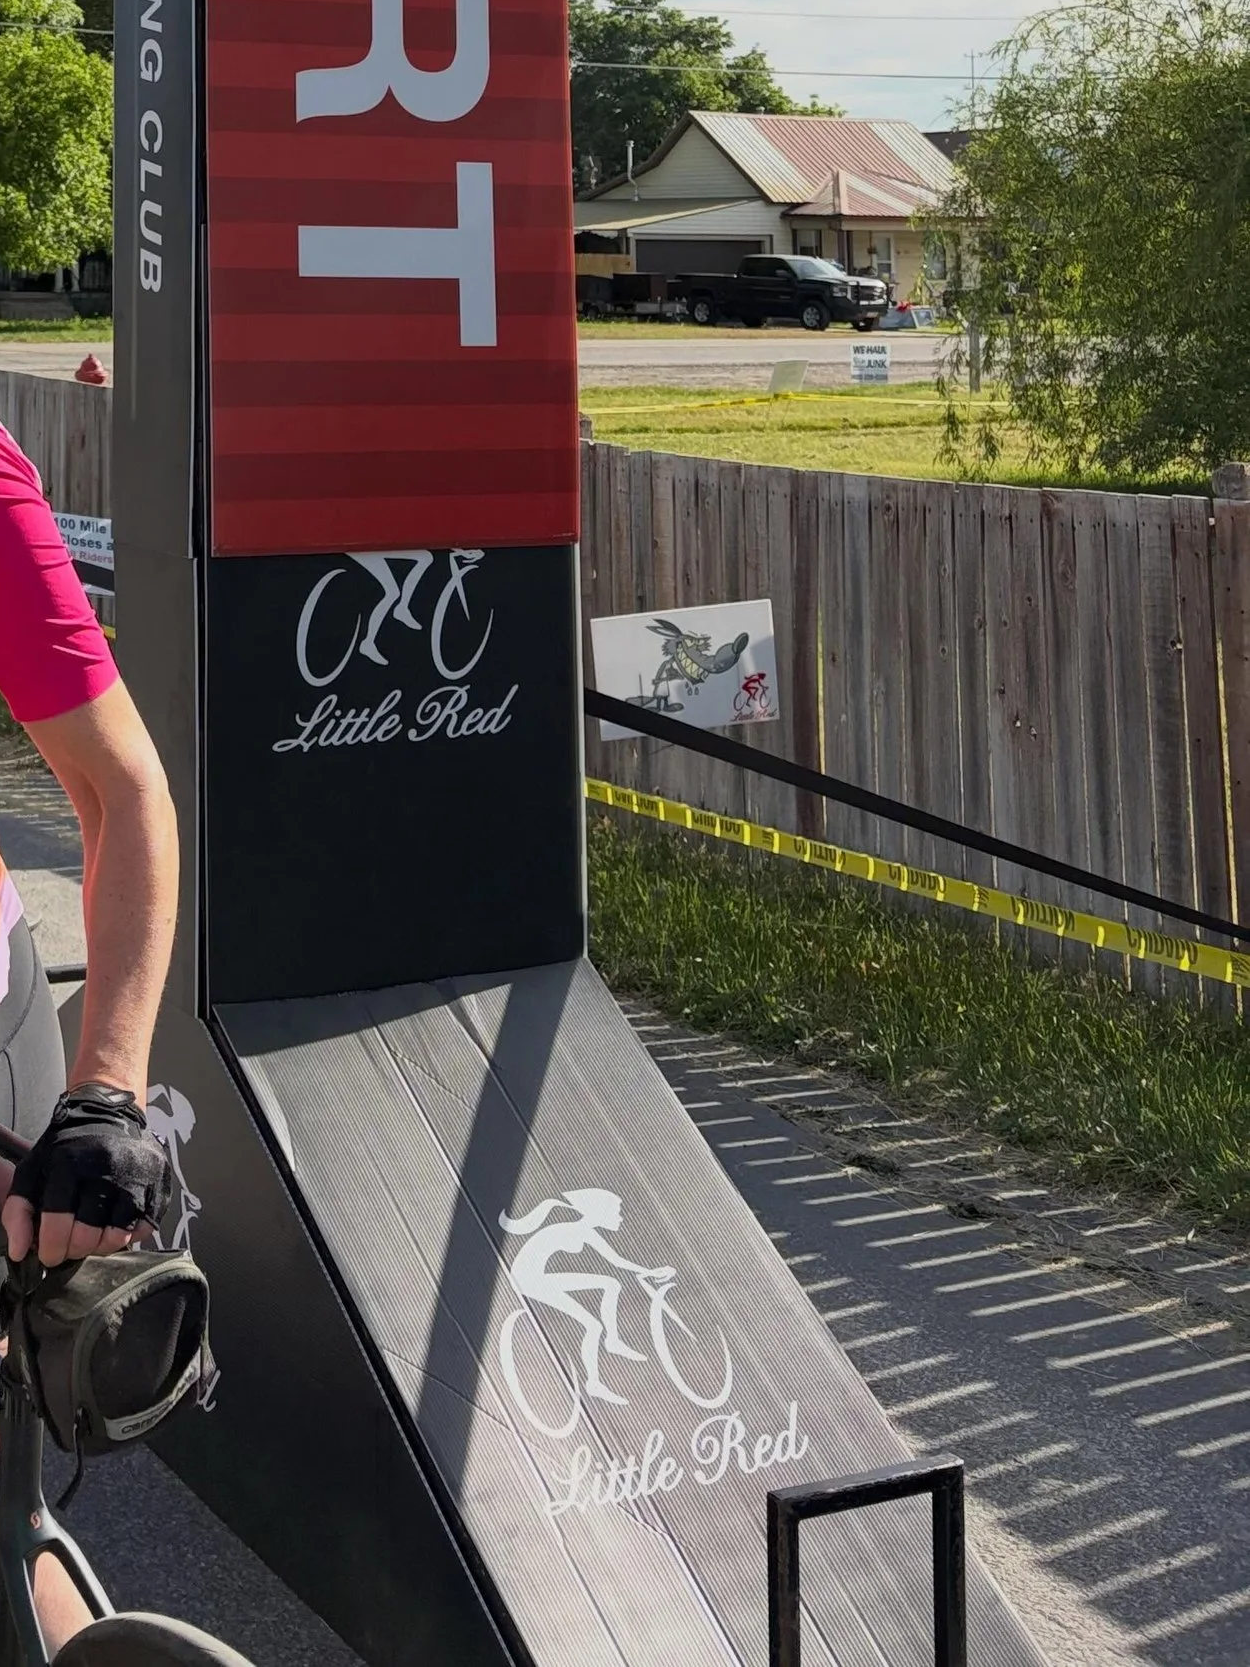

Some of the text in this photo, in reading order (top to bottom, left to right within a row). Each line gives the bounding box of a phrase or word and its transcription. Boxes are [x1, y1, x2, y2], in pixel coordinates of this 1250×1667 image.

[140, 109, 164, 294] CLUB
[80, 520, 107, 534] Mile
[272, 684, 519, 753] Little Red
[546, 1400, 809, 1516] Little Red
